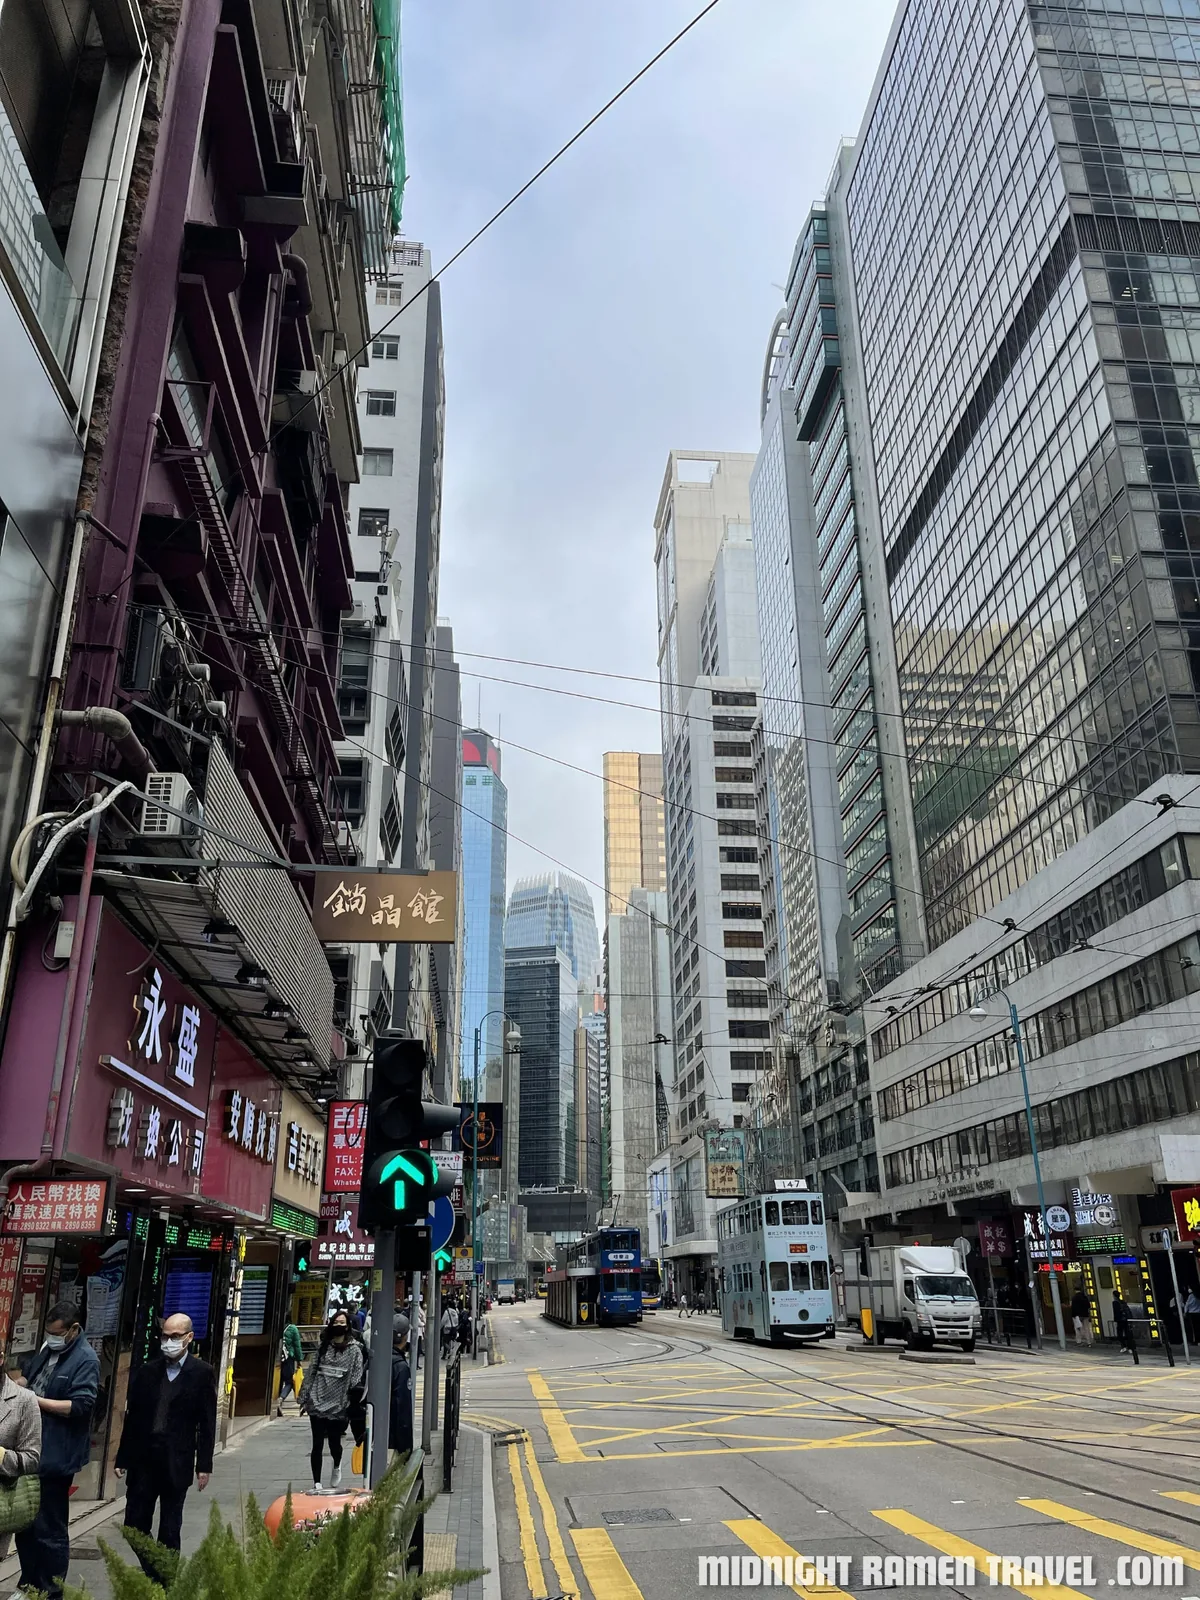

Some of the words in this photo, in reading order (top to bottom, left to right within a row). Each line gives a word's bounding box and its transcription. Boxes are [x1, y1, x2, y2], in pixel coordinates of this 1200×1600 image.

[137, 967, 201, 1087] 永盛
[113, 1088, 205, 1177] 找換公司
[228, 1090, 277, 1164] 安順找換
[335, 1155, 357, 1164] TEL:
[334, 1168, 357, 1176] FAX:
[782, 1180, 800, 1188] 147
[12, 1184, 101, 1202] 人民幣找換
[321, 1206, 339, 1216] 0095
[984, 1225, 1007, 1240] 成記
[335, 1253, 345, 1261] KEE
[345, 1253, 364, 1261] MONEY
[329, 1282, 365, 1305] 成記
